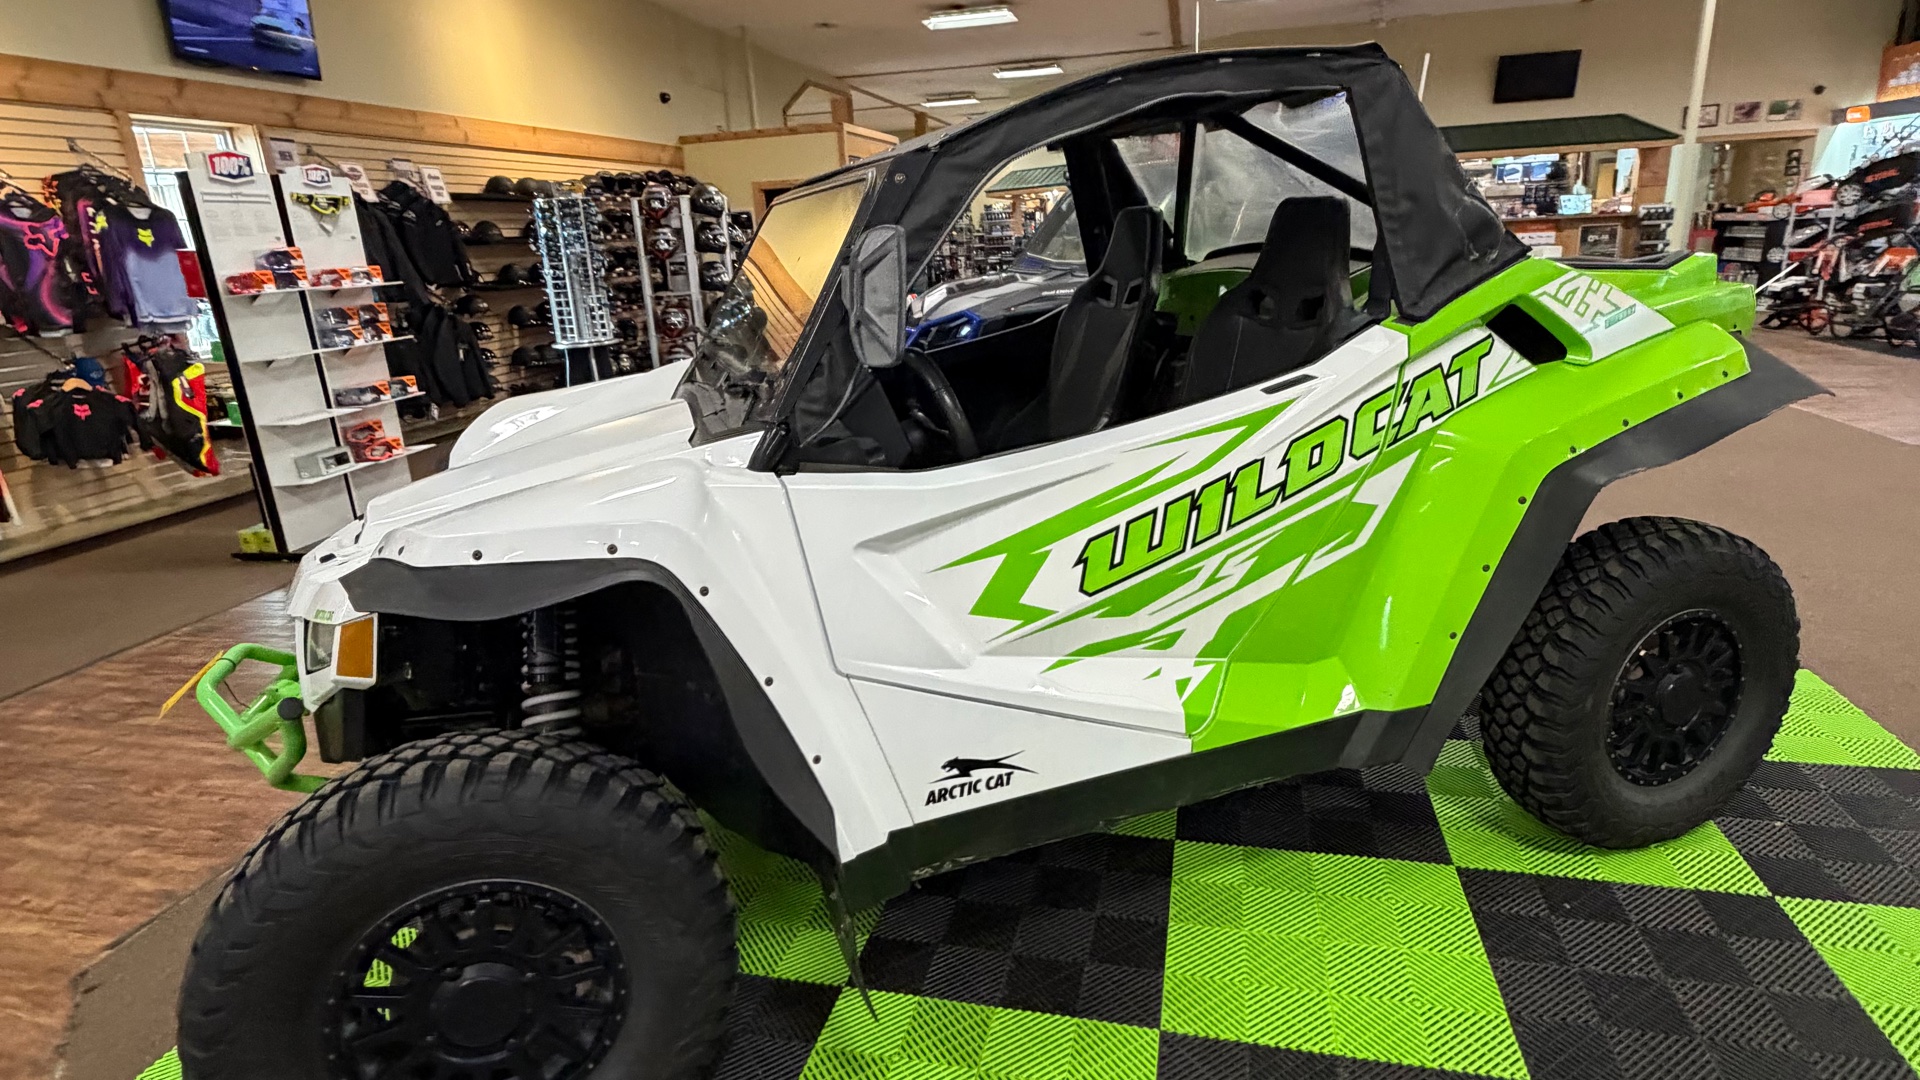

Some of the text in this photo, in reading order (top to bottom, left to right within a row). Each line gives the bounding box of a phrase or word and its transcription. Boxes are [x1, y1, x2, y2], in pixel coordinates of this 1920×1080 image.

[212, 155, 251, 176] 100%
[306, 169, 329, 183] 100%
[1072, 333, 1495, 597] WILDCAT
[924, 771, 1015, 807] ARCTIC CAT
